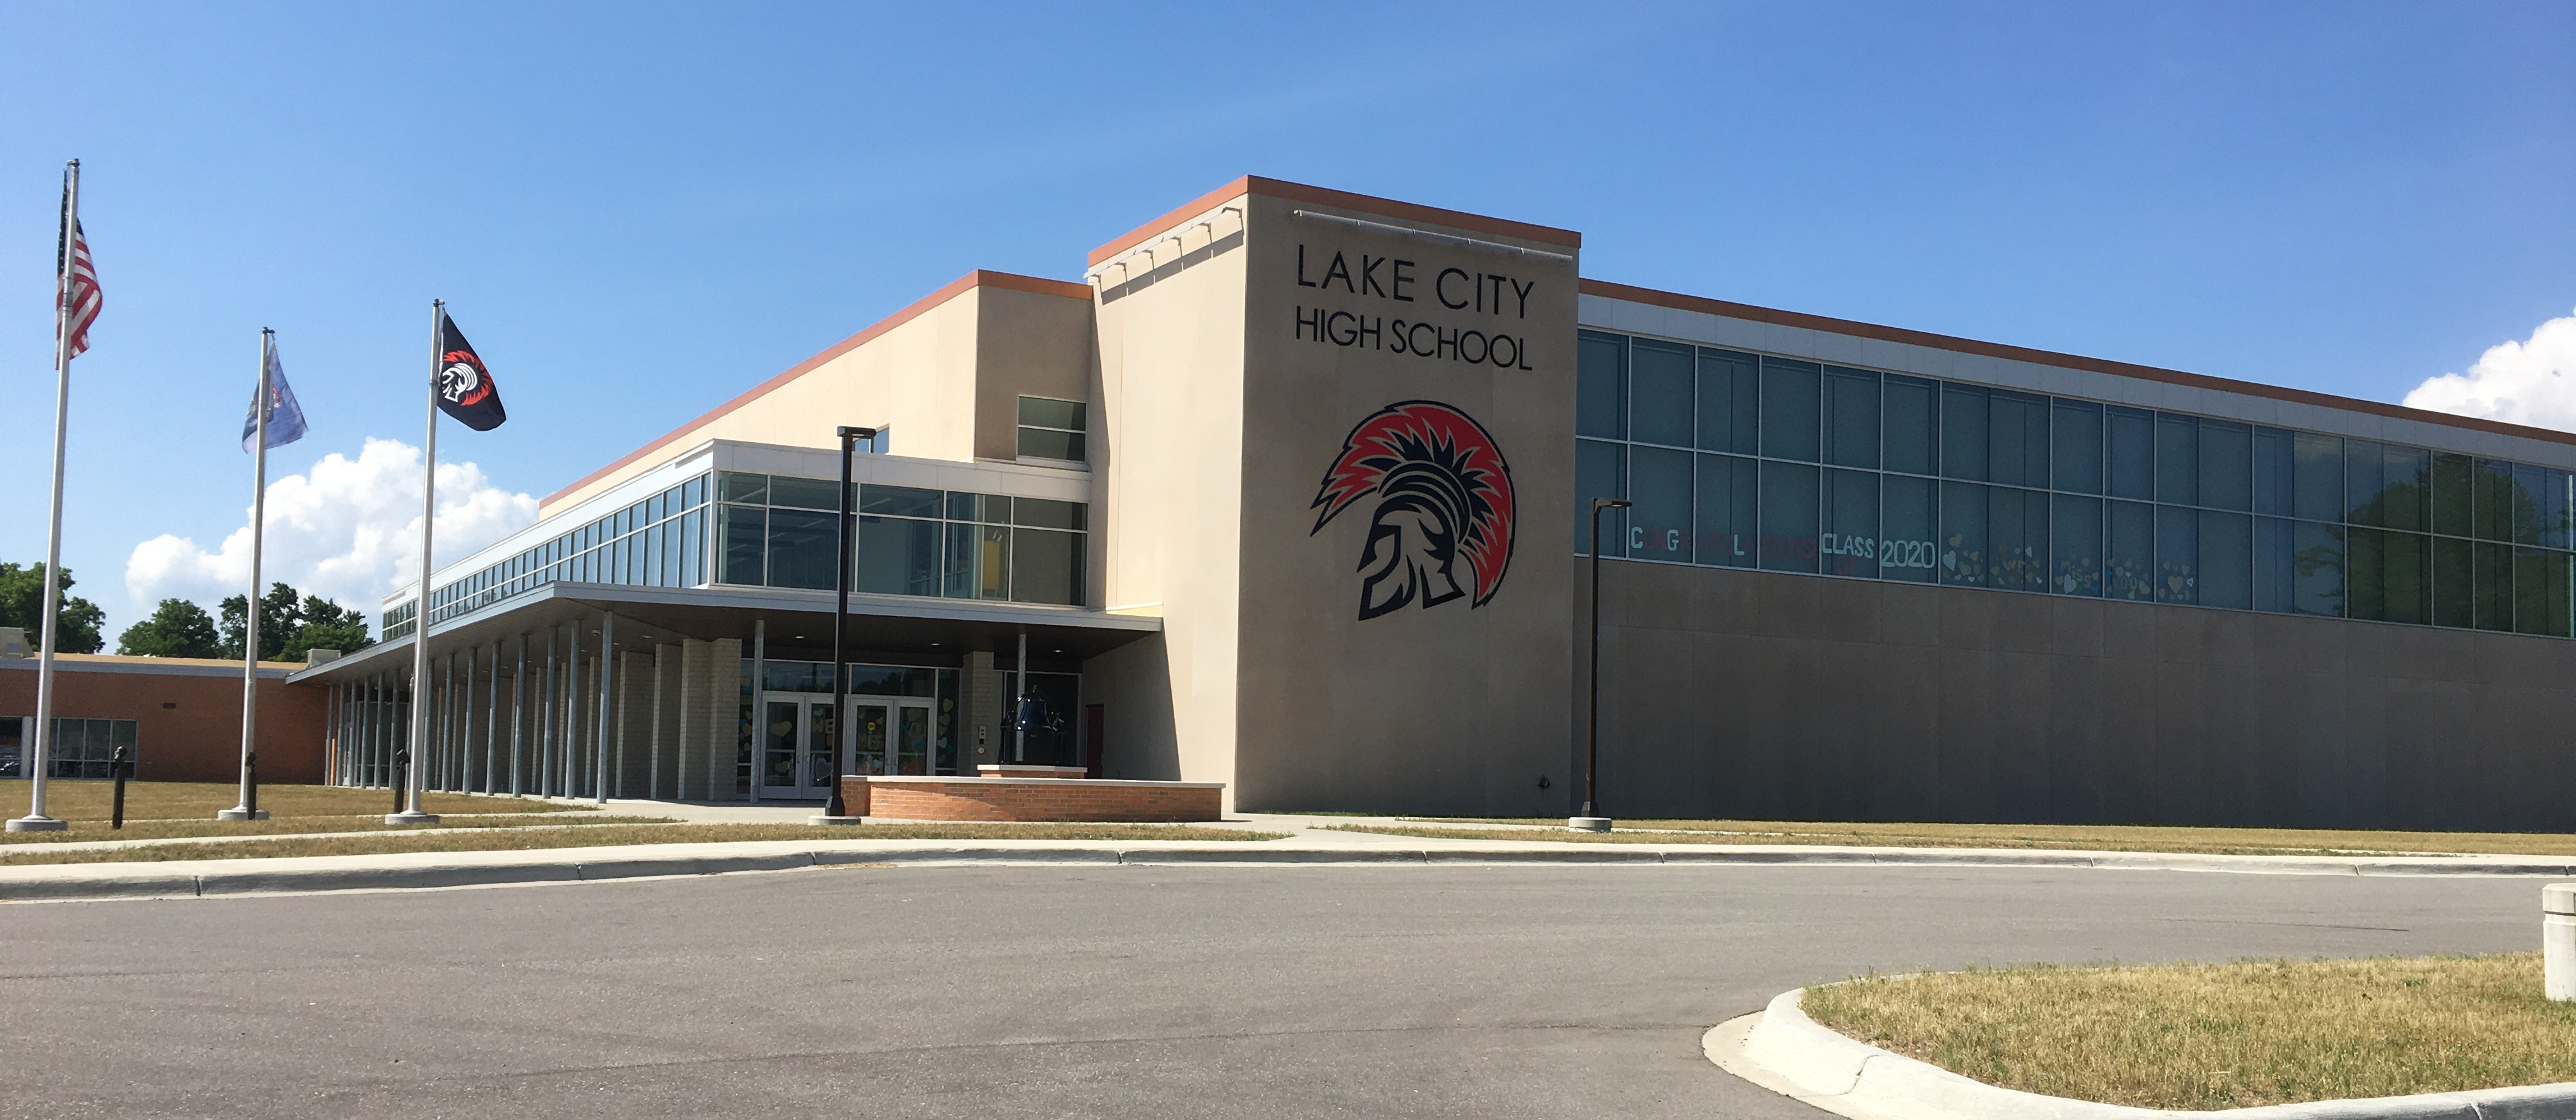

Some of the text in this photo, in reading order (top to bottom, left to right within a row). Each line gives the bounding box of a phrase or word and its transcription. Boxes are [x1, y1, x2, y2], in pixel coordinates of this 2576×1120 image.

[1298, 244, 1534, 319] LAKE CITY
[1296, 305, 1533, 371] HIGH SCHOOL
[1822, 533, 1874, 559] CLASS
[1882, 540, 1936, 568] 2020
